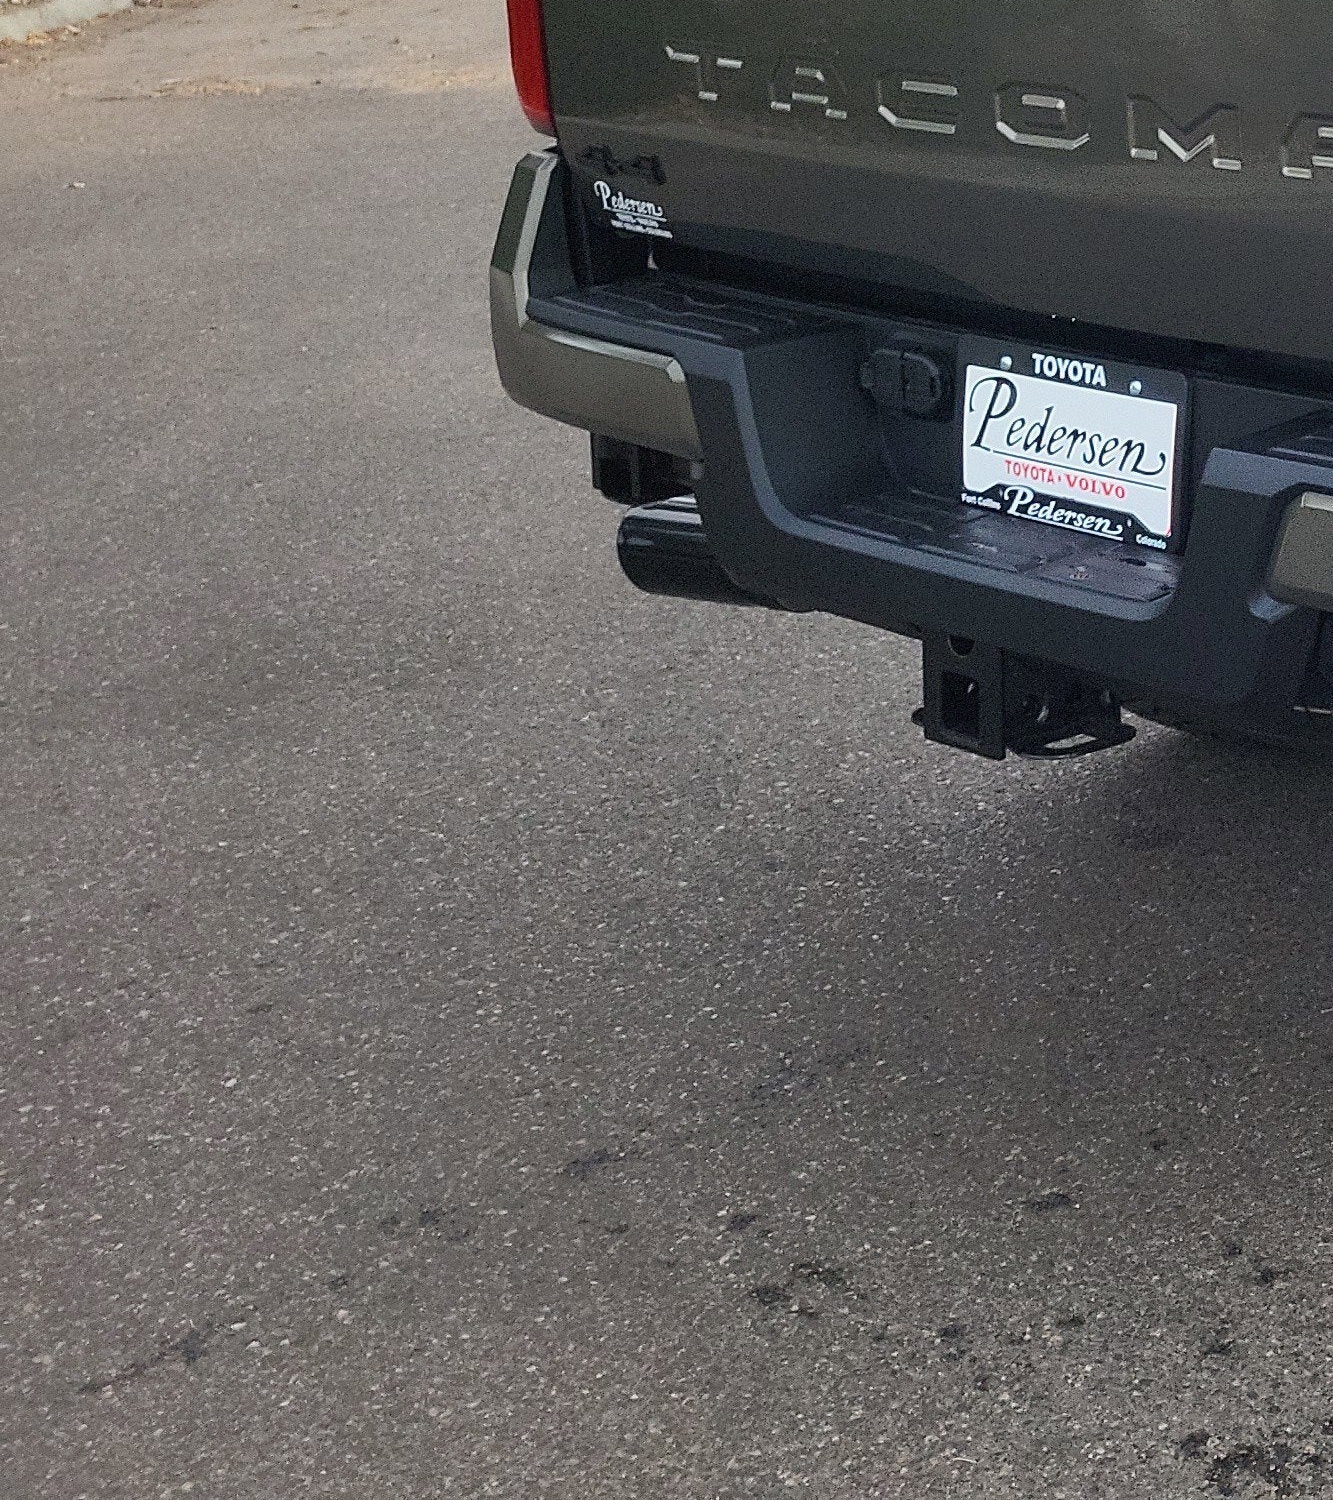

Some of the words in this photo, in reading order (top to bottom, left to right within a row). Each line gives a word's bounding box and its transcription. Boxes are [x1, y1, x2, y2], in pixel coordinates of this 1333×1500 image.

[593, 180, 664, 217] Pedersen
[1032, 352, 1107, 387] TOYOTA
[969, 376, 1167, 477] Pedersen
[1005, 459, 1056, 484] TOYOTA
[1065, 473, 1127, 500] VOLVO
[1003, 485, 1124, 536] Pedersen
